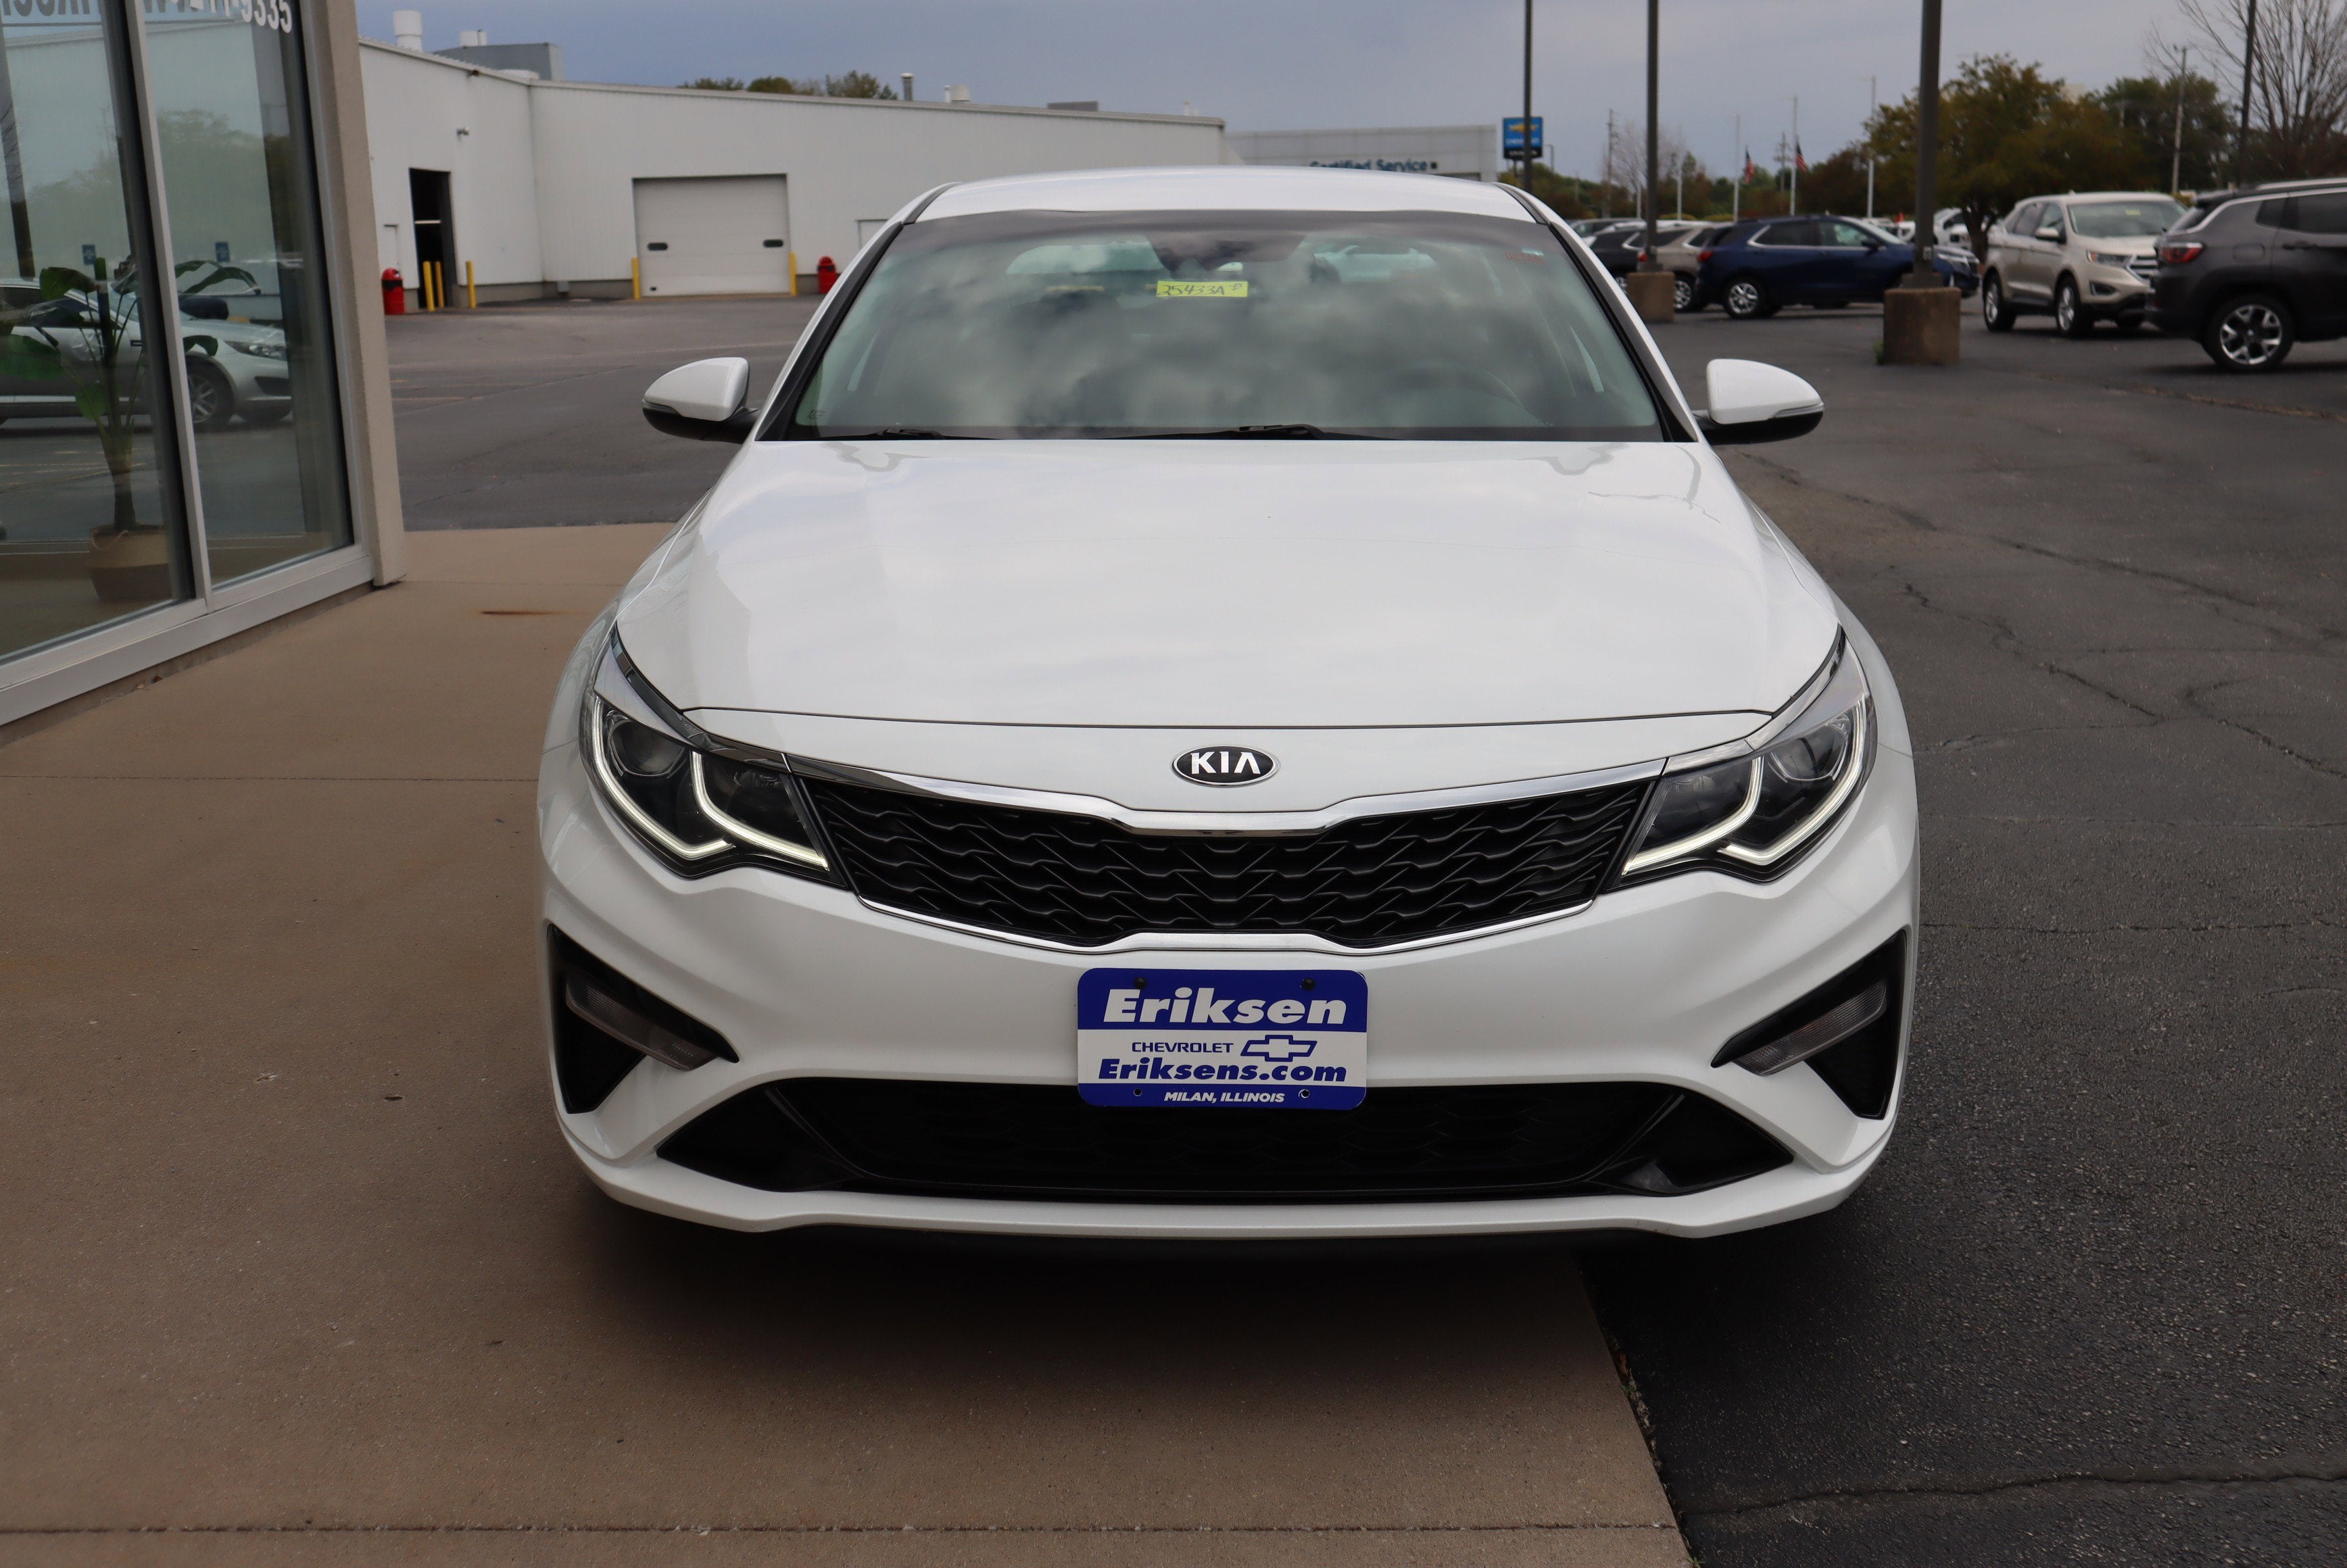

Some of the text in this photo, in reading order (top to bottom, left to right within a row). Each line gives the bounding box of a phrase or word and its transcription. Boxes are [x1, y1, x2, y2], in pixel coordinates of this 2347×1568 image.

[1157, 285, 1225, 296] 25433A
[1190, 751, 1261, 775] KIA
[1103, 987, 1347, 1025] Eriksen
[1132, 1042, 1234, 1053] CHEVROLET
[1098, 1057, 1347, 1082] Eriksens.com
[1164, 1092, 1285, 1104] MILAN, ILLINOIS
